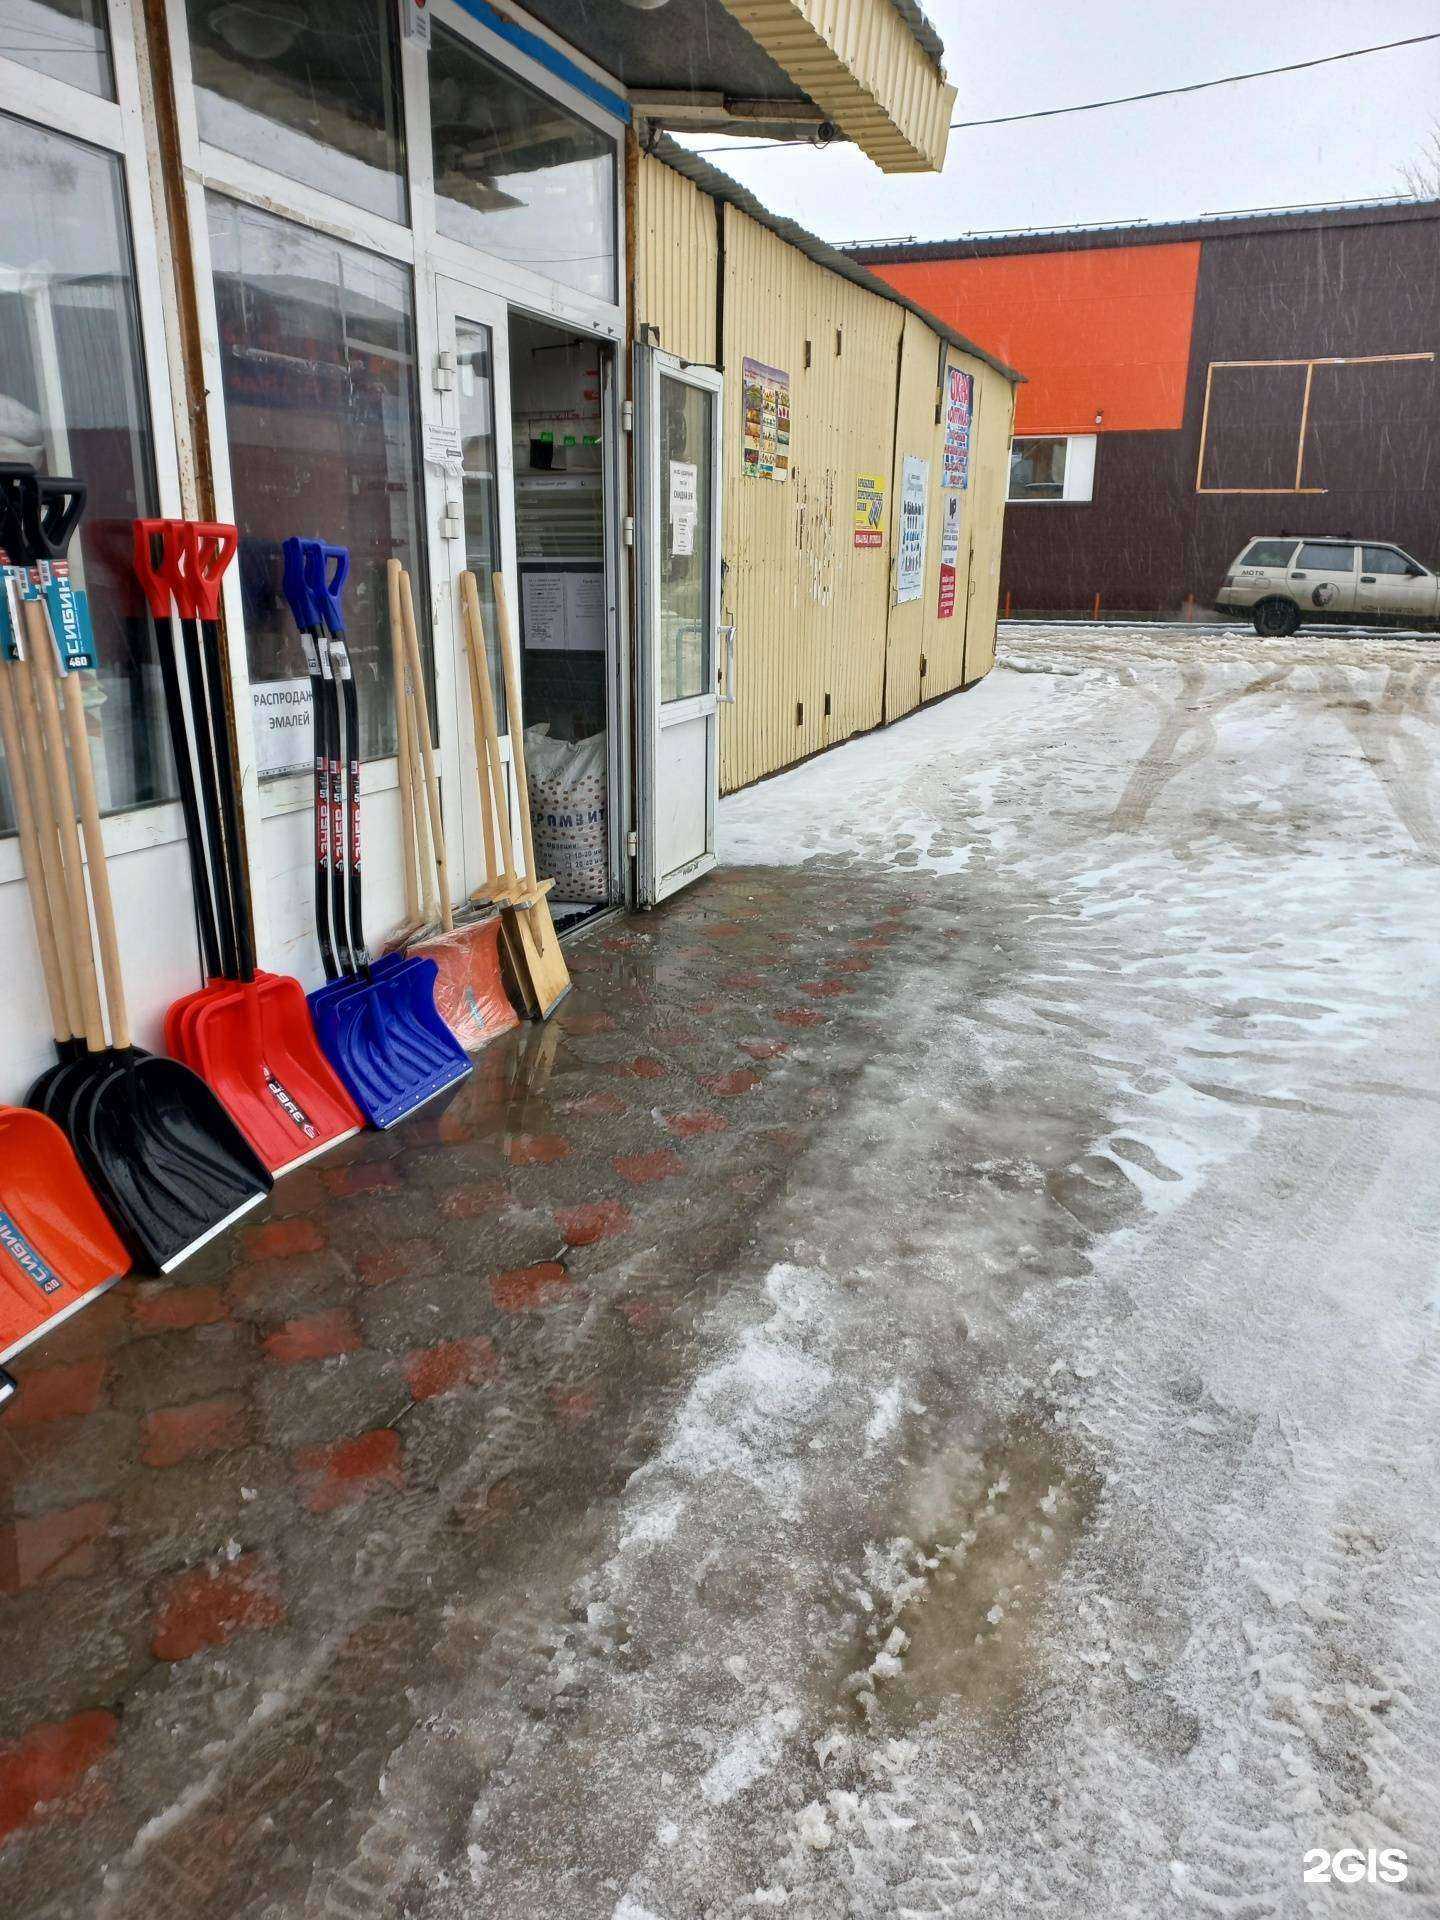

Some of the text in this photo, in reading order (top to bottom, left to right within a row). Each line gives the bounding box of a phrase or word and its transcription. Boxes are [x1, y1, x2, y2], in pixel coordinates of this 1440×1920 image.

[57, 577, 80, 654] СИБИН
[268, 710, 311, 730] ЭМАЛЕЙ
[268, 1083, 305, 1123] ЗУБР
